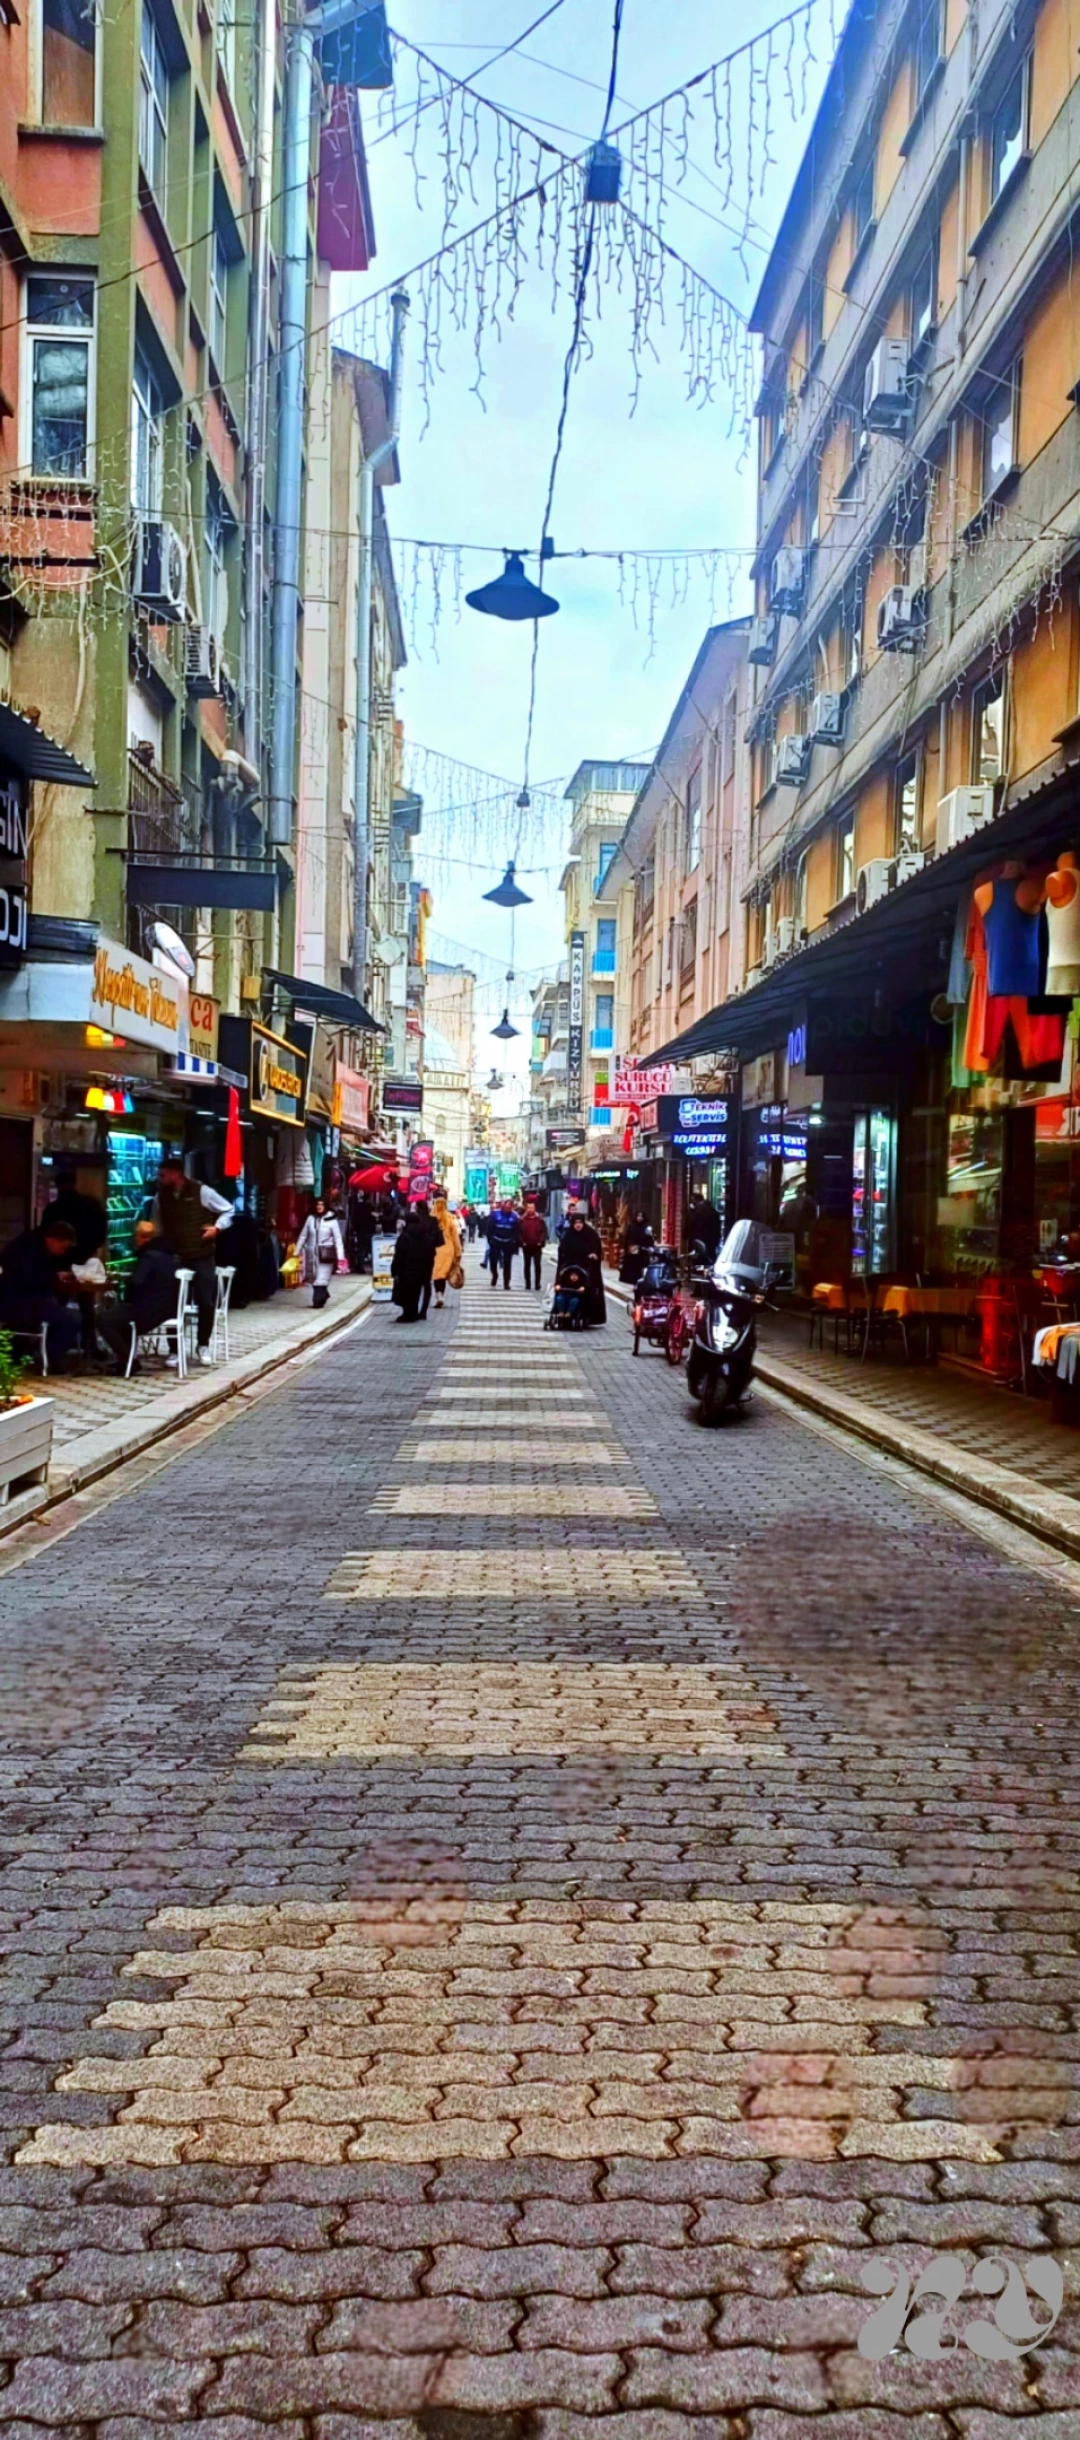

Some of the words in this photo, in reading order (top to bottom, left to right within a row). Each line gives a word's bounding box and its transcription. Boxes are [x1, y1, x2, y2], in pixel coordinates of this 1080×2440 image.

[573, 952, 581, 1021] KAMPÜS
[571, 1029, 580, 1057] KIZ
[570, 1062, 579, 1109] YURDU
[614, 1069, 671, 1082] SÜRÜCÜ
[614, 1082, 671, 1093] KURSU
[690, 1112, 726, 1122] SERVİS
